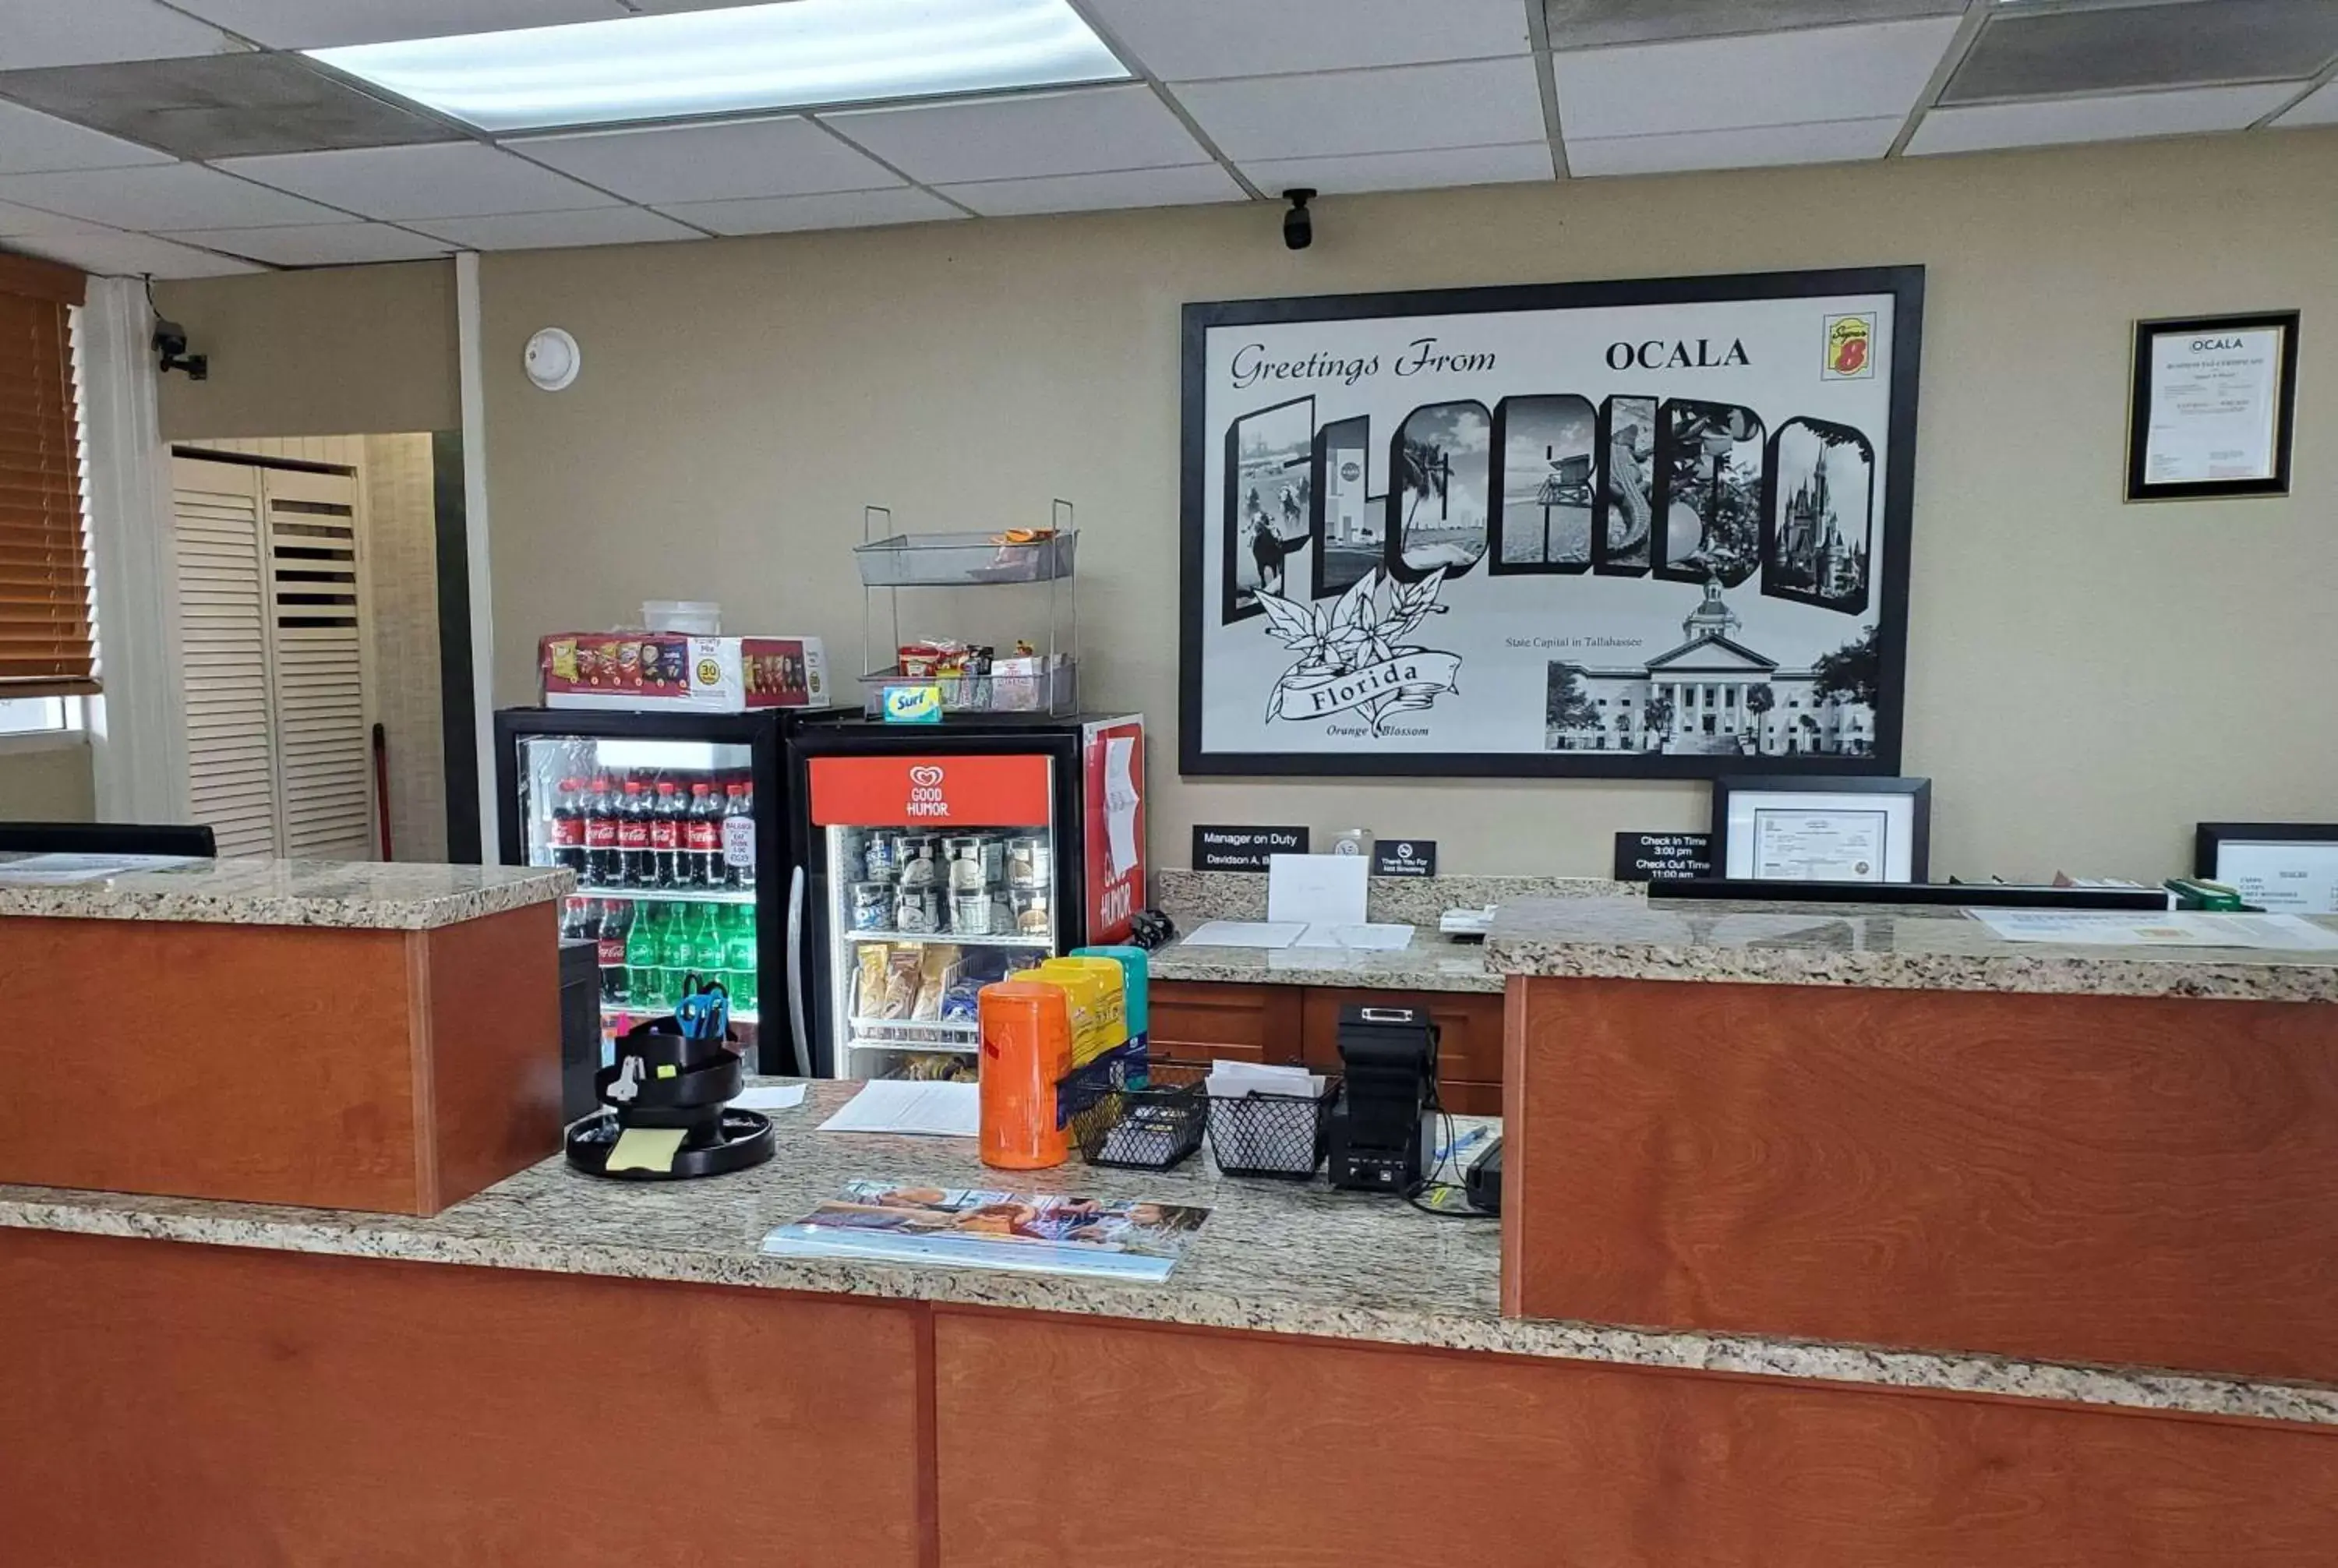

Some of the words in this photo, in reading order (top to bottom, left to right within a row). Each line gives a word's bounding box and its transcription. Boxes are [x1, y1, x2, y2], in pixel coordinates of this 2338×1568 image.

[2192, 338, 2244, 351] OCALA
[1605, 337, 1751, 370] OCALA
[1835, 337, 1867, 373] 8
[1231, 344, 1379, 389] Greetings
[1395, 337, 1496, 376] From
[1505, 637, 1531, 648] State
[1572, 637, 1581, 648] in
[1584, 635, 1643, 648] Tallahassee
[701, 665, 717, 676] 30
[1310, 663, 1418, 711] Florida
[1326, 725, 1369, 737] Orange
[1382, 726, 1429, 736] Blossom
[911, 787, 942, 802] GOOD
[906, 801, 951, 817] HUMOR
[1204, 832, 1252, 846] Manager
[1270, 833, 1298, 846] Duty
[1640, 836, 1671, 846] Check
[1684, 836, 1708, 846] Time
[1655, 846, 1675, 855] 3:00
[1676, 848, 1692, 856] pm
[1207, 854, 1248, 864] Davidson
[1250, 855, 1260, 865] A.
[1636, 859, 1665, 869] Check
[1668, 860, 1685, 869] Out
[1686, 860, 1711, 869] Time
[1100, 881, 1132, 930] HUMOR
